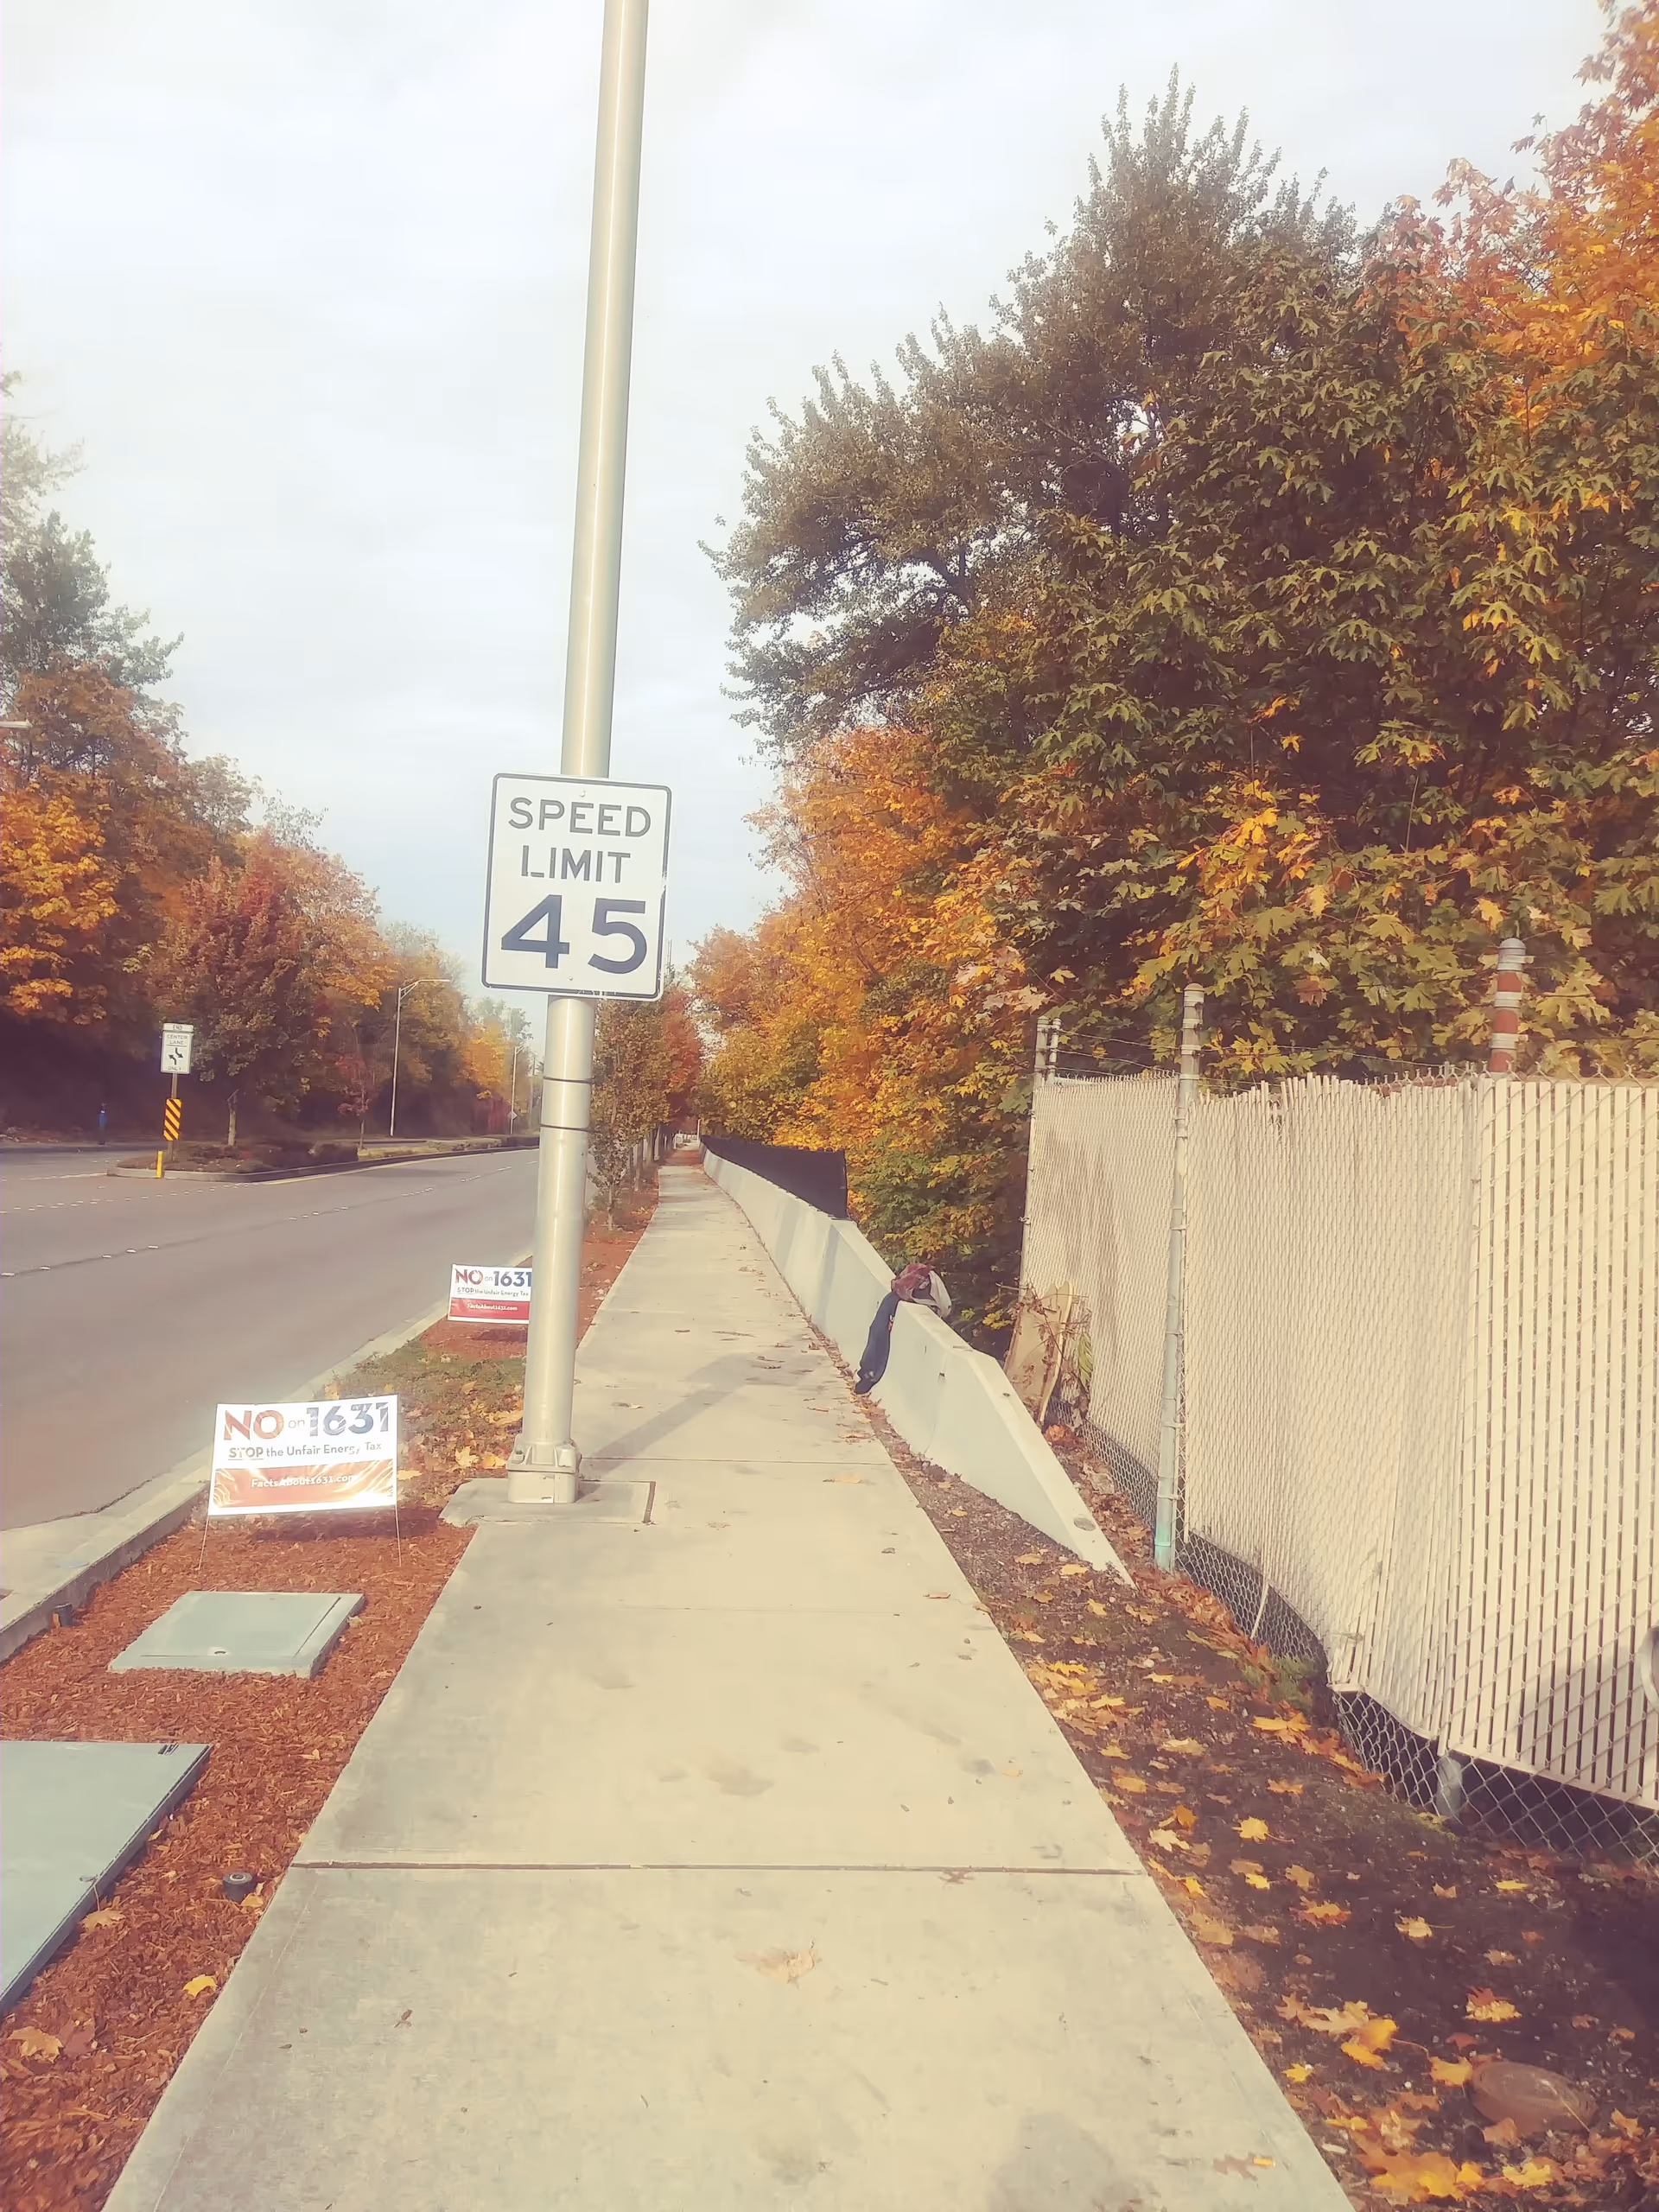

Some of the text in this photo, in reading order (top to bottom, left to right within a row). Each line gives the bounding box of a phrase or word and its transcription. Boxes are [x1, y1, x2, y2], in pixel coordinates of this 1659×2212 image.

[508, 797, 651, 837] SPEED
[521, 845, 631, 883] LIMIT
[501, 893, 647, 974] 45
[455, 1268, 483, 1285] NO
[493, 1271, 531, 1287] 1631
[224, 1402, 388, 1440] NO on 1631
[228, 1446, 264, 1459] STOP
[266, 1446, 283, 1457] the
[287, 1445, 321, 1456] Unfair
[365, 1441, 381, 1451] Tax
